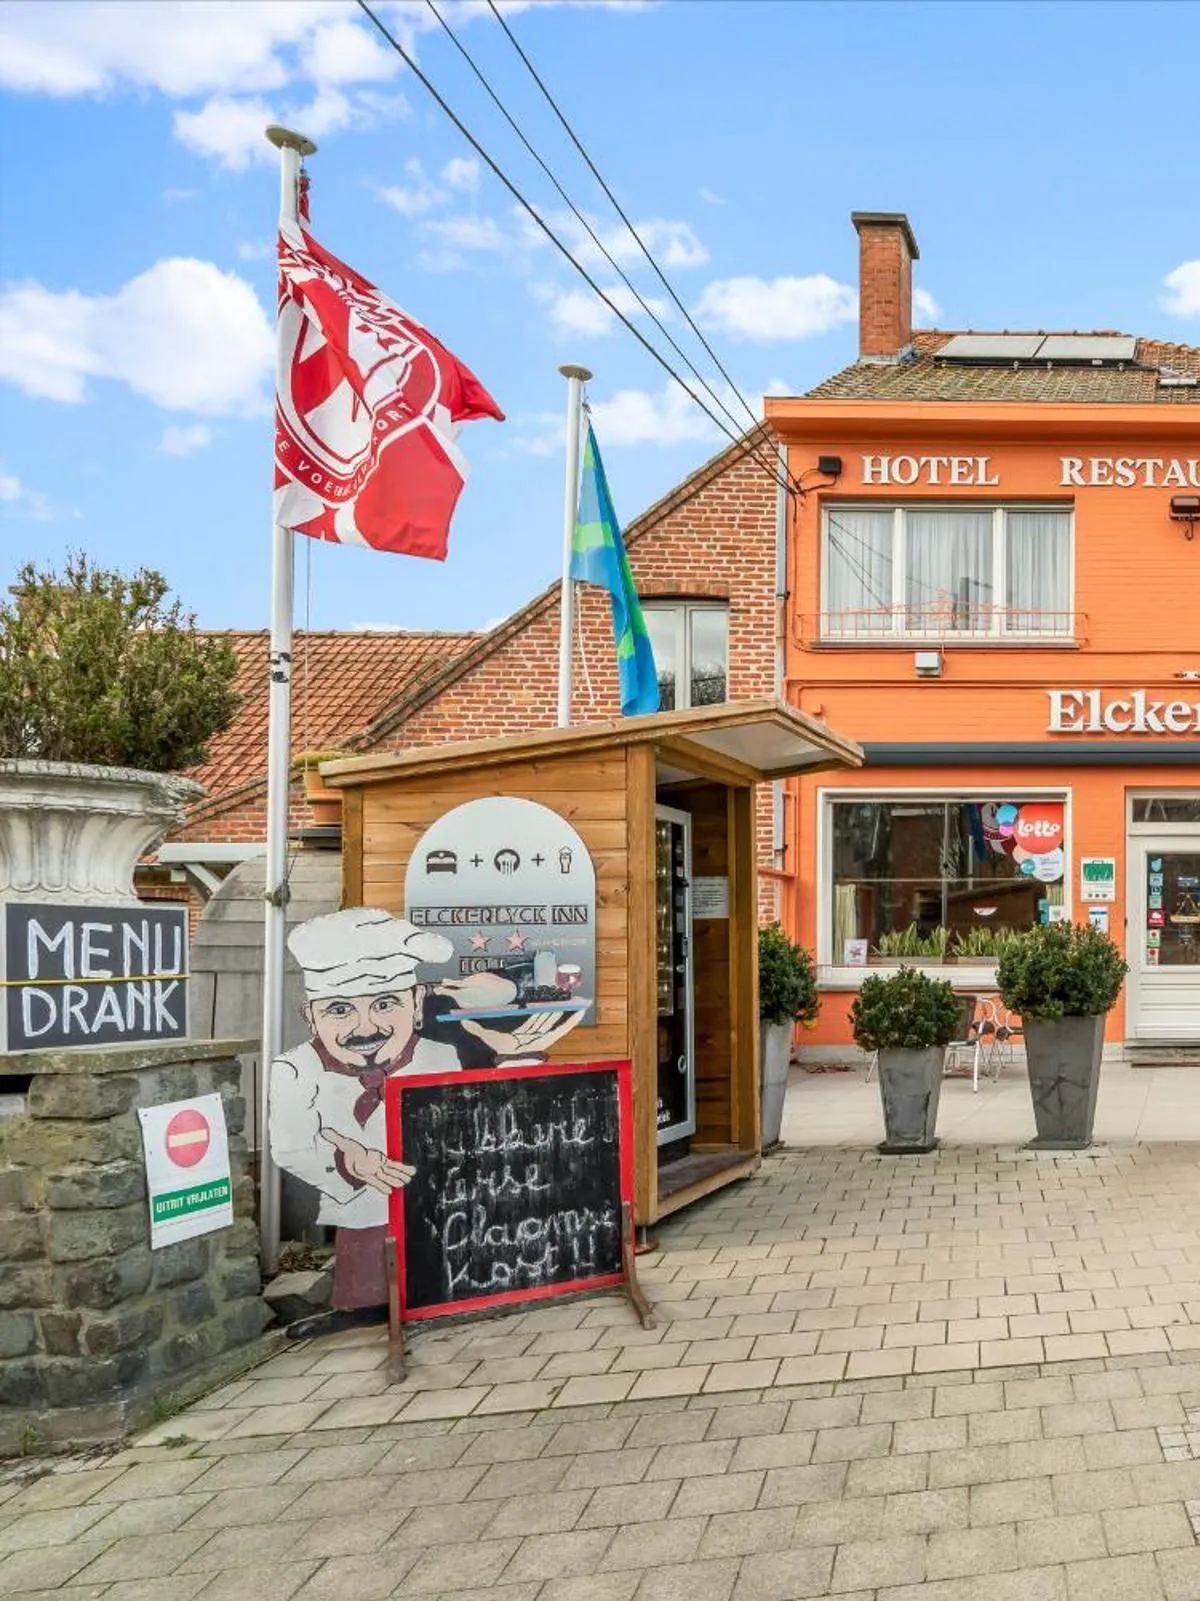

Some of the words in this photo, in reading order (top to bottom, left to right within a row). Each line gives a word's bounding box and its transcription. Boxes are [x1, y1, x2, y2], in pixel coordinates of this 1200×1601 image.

[861, 455, 999, 485] HOTEL
[410, 906, 547, 925] ELCKERLYCK
[550, 905, 588, 924] INN
[28, 918, 182, 980] MENU
[22, 980, 180, 1038] DRANK
[156, 1198, 185, 1214] UITRIT
[186, 1186, 229, 1207] VRIJLATEN
